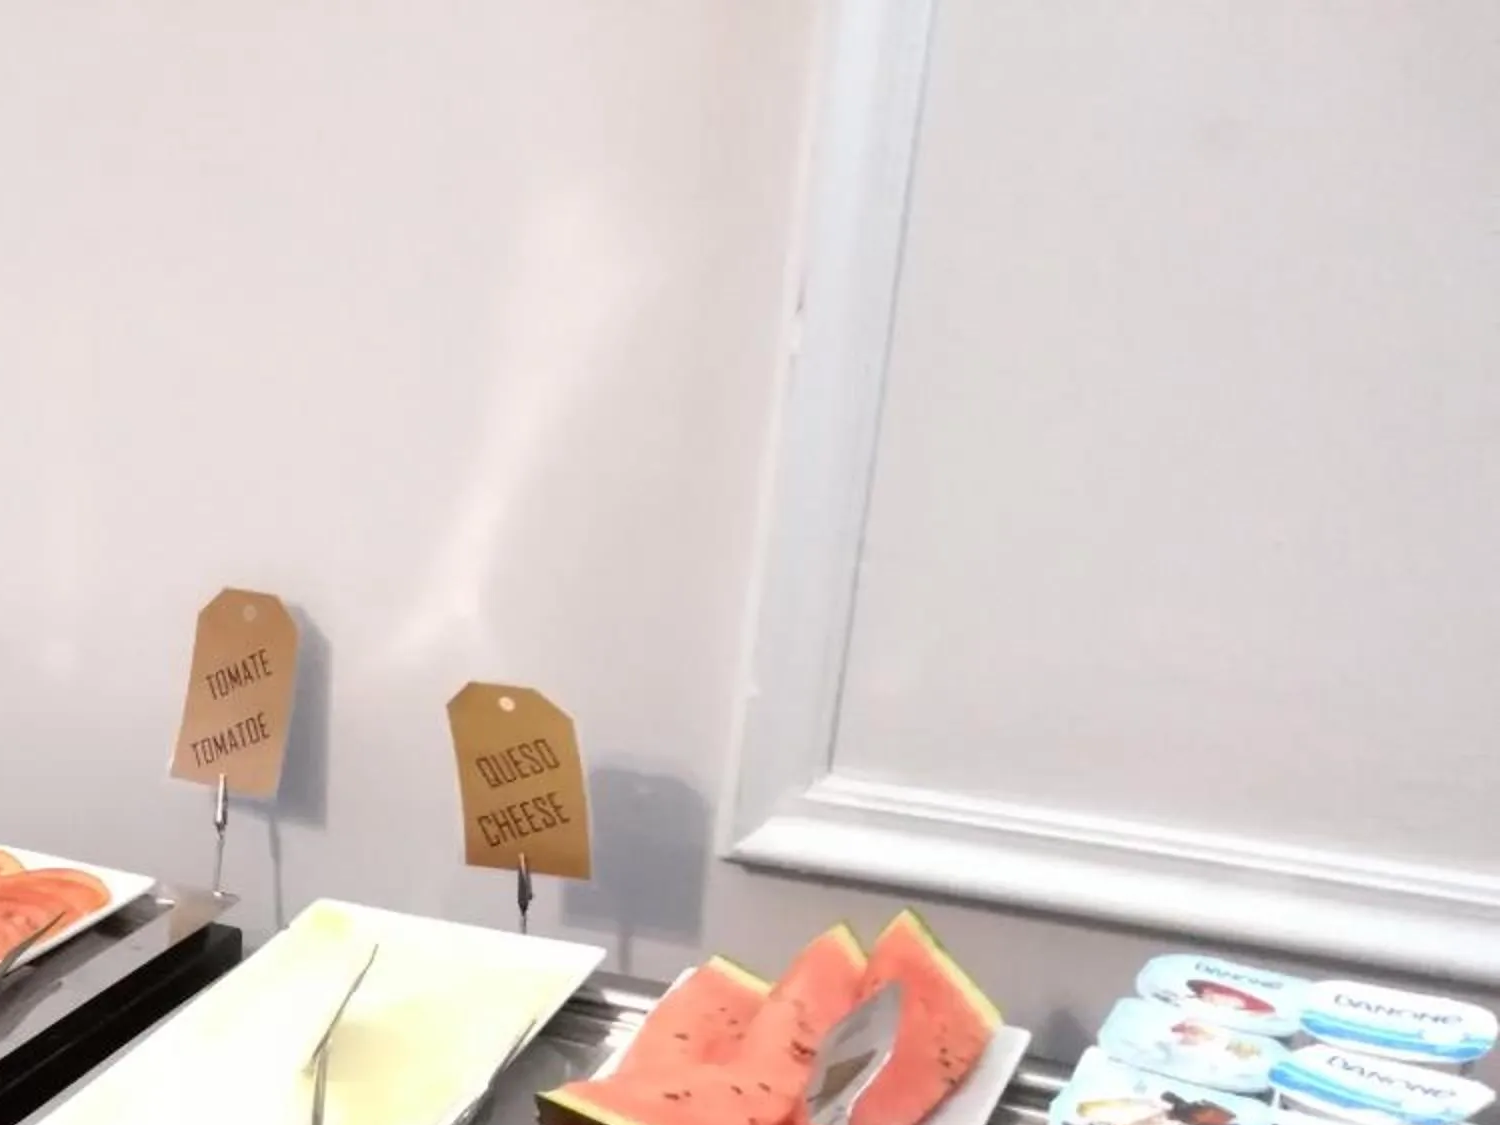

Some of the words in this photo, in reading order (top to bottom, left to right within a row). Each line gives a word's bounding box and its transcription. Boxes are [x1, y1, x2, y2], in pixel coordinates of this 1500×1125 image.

[205, 648, 272, 701] TOMATE
[190, 712, 271, 769] TOMATOE
[475, 738, 560, 788] QUESO
[477, 792, 570, 848] CHEESE
